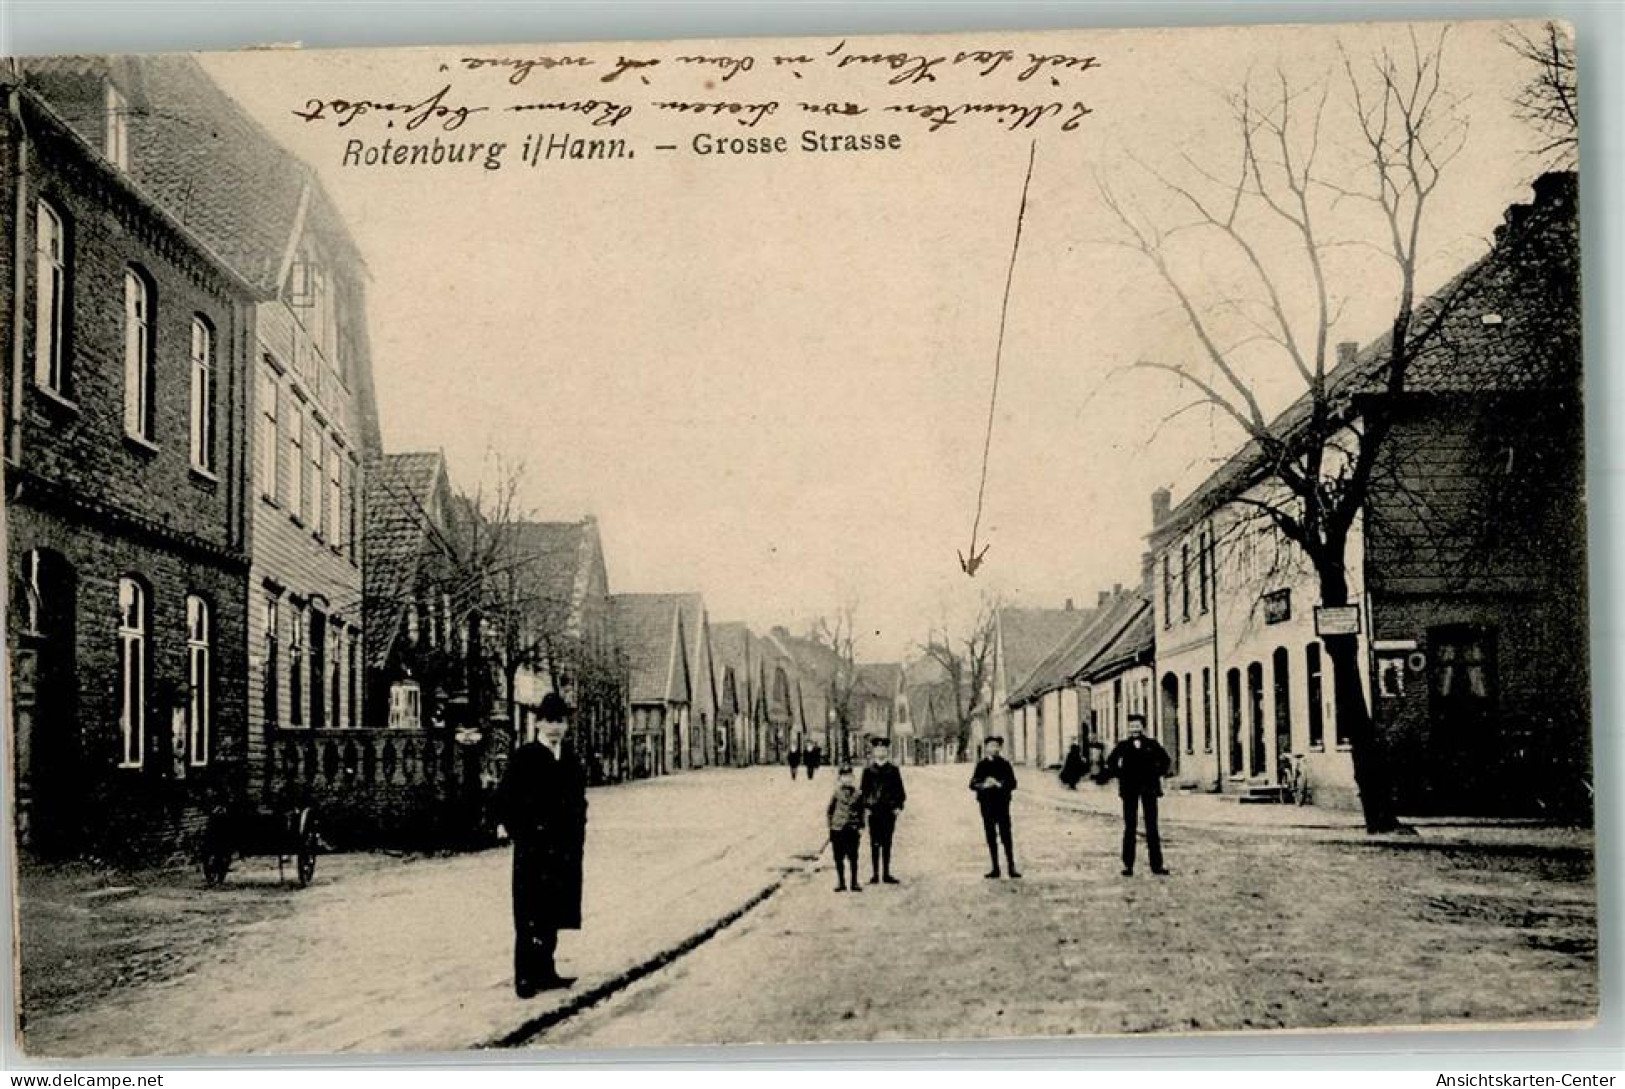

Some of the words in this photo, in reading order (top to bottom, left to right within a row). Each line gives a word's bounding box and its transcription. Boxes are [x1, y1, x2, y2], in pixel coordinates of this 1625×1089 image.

[953, 49, 1014, 77] das
[1061, 101, 1093, 132] 2
[342, 137, 508, 170] Rotenburg
[692, 133, 788, 155] Grosse
[801, 130, 902, 152] Strasse
